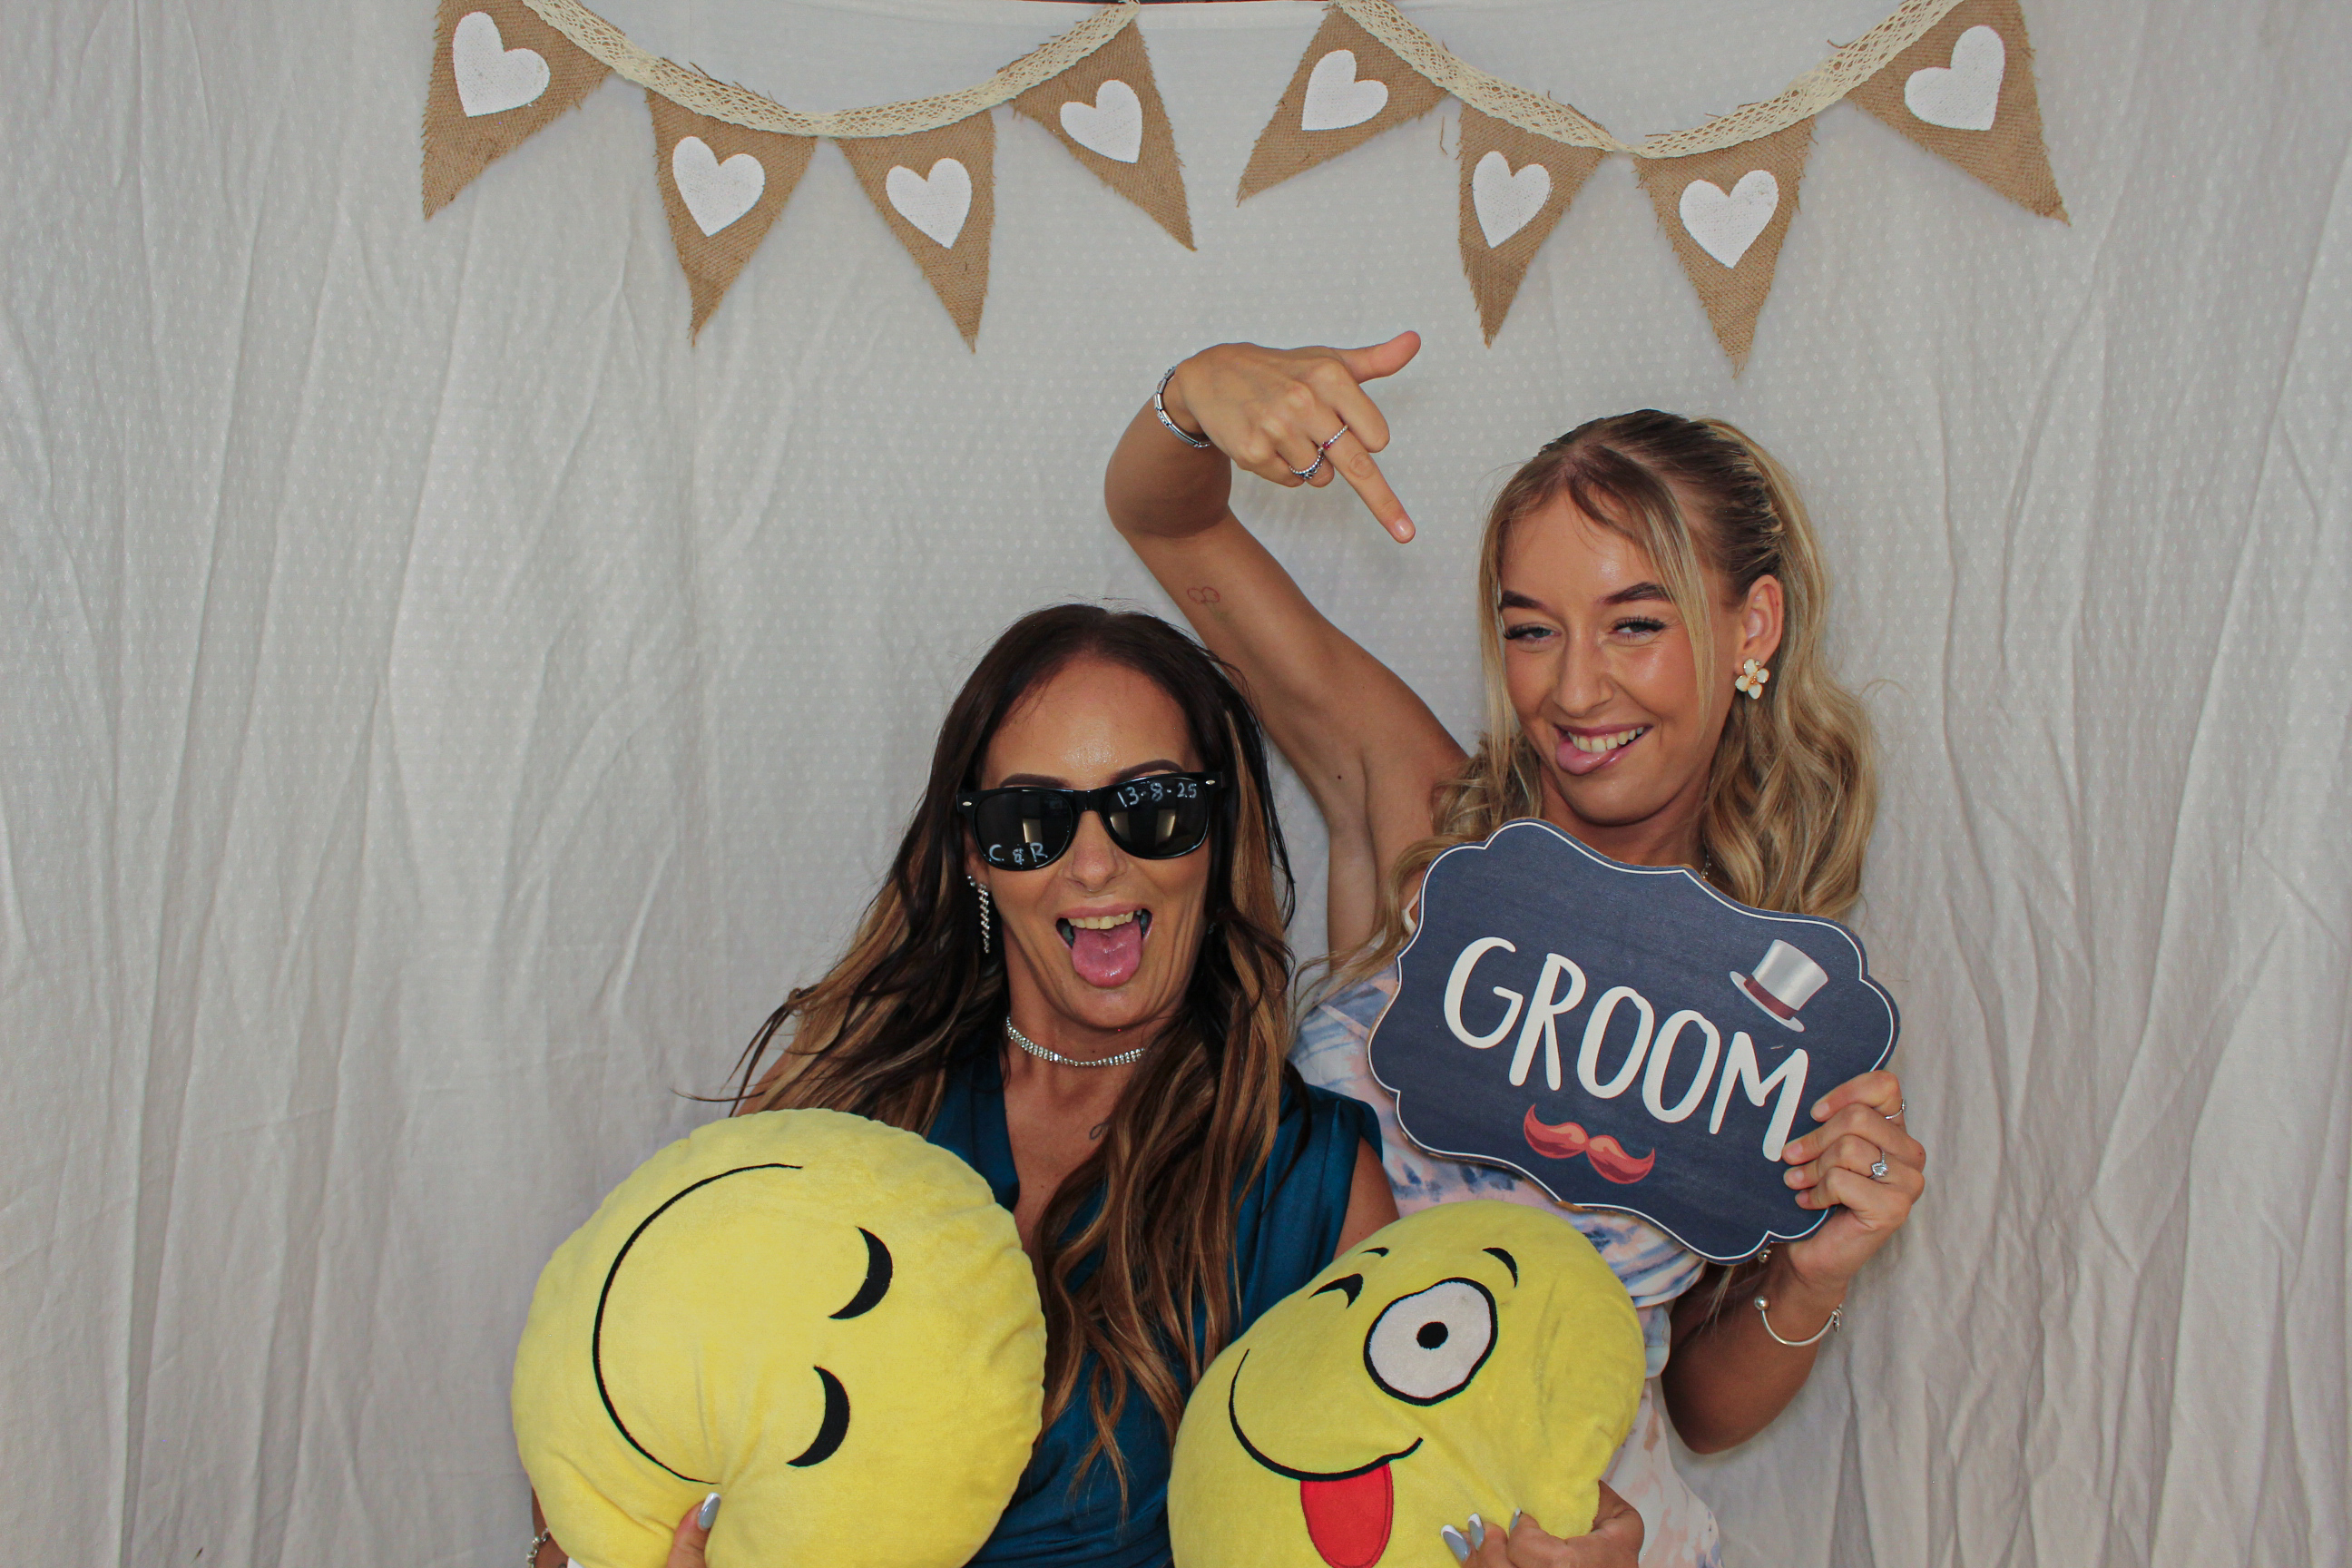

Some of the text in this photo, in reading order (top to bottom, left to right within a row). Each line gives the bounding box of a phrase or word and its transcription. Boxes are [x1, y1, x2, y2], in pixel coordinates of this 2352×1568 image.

[989, 844, 1004, 861] C
[1030, 842, 1048, 862] R
[1443, 936, 1809, 1162] GROOM
